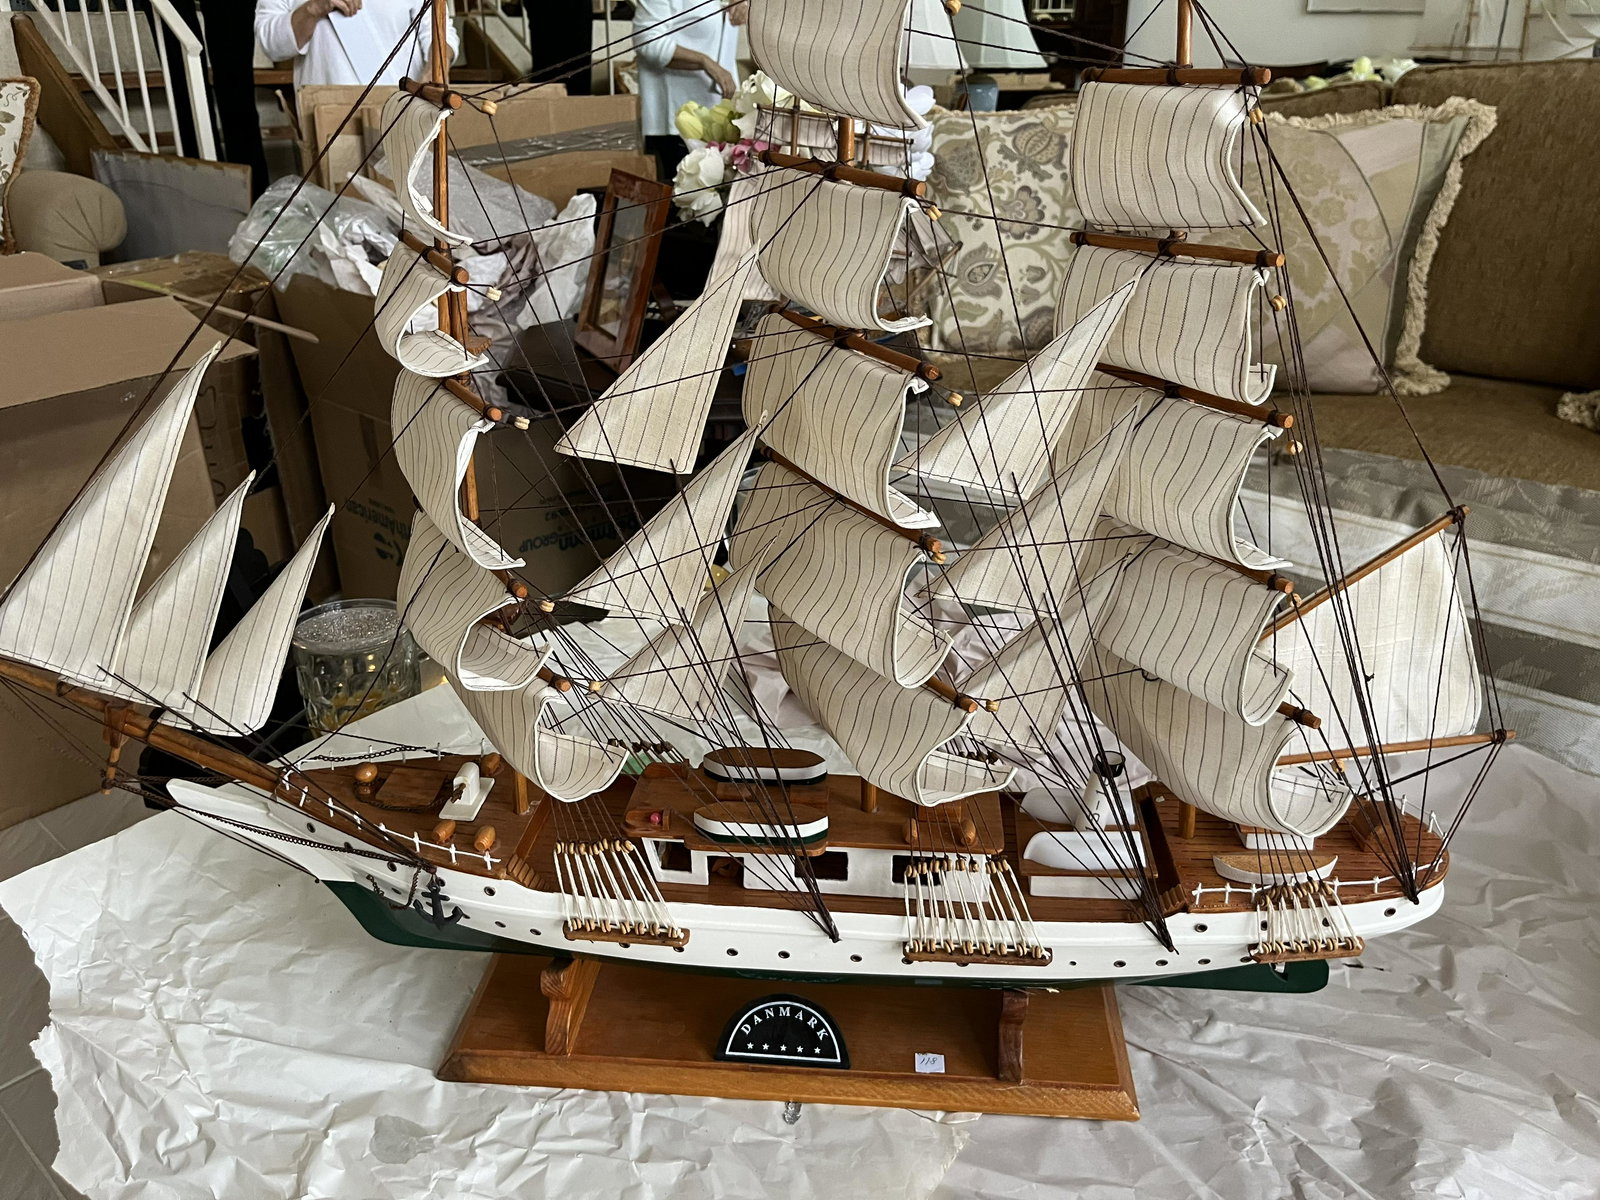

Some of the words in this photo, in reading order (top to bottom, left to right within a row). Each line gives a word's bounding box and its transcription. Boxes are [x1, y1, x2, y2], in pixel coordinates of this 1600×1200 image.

[518, 532, 558, 553] GROUP
[741, 1006, 829, 1041] DANMARK
[919, 1057, 938, 1066] 118
